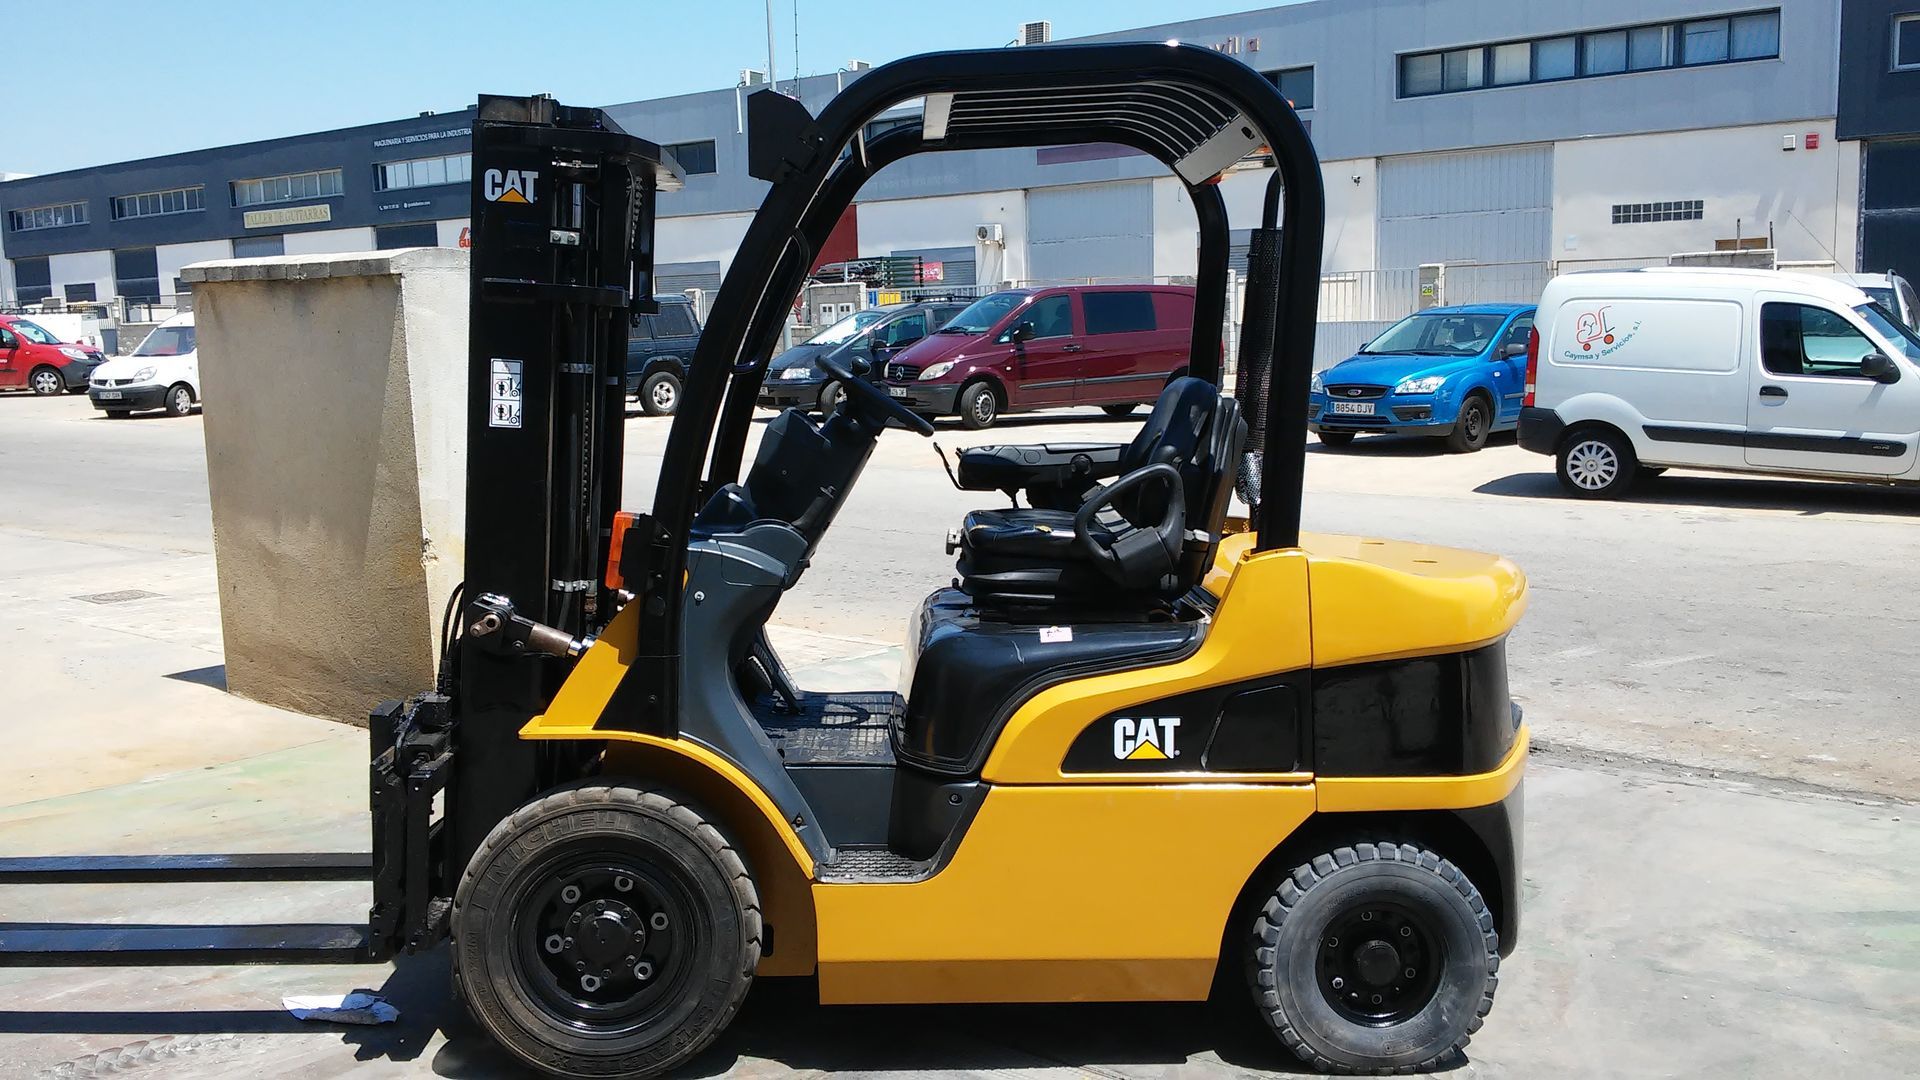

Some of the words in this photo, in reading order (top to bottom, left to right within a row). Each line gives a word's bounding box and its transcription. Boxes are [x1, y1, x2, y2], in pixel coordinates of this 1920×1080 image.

[374, 138, 402, 148] MAQUINARIA
[405, 134, 428, 143] SERVICIOS
[427, 132, 440, 141] PARA
[440, 131, 447, 139] LA
[447, 127, 472, 138] INDUSTRIA
[484, 168, 539, 204] CAT
[246, 213, 273, 226] TALLER
[1564, 350, 1594, 361] Caymsa
[1595, 352, 1600, 361] y
[1335, 403, 1355, 413] 8854
[1357, 404, 1373, 414] DJV
[1114, 717, 1181, 760] CAT
